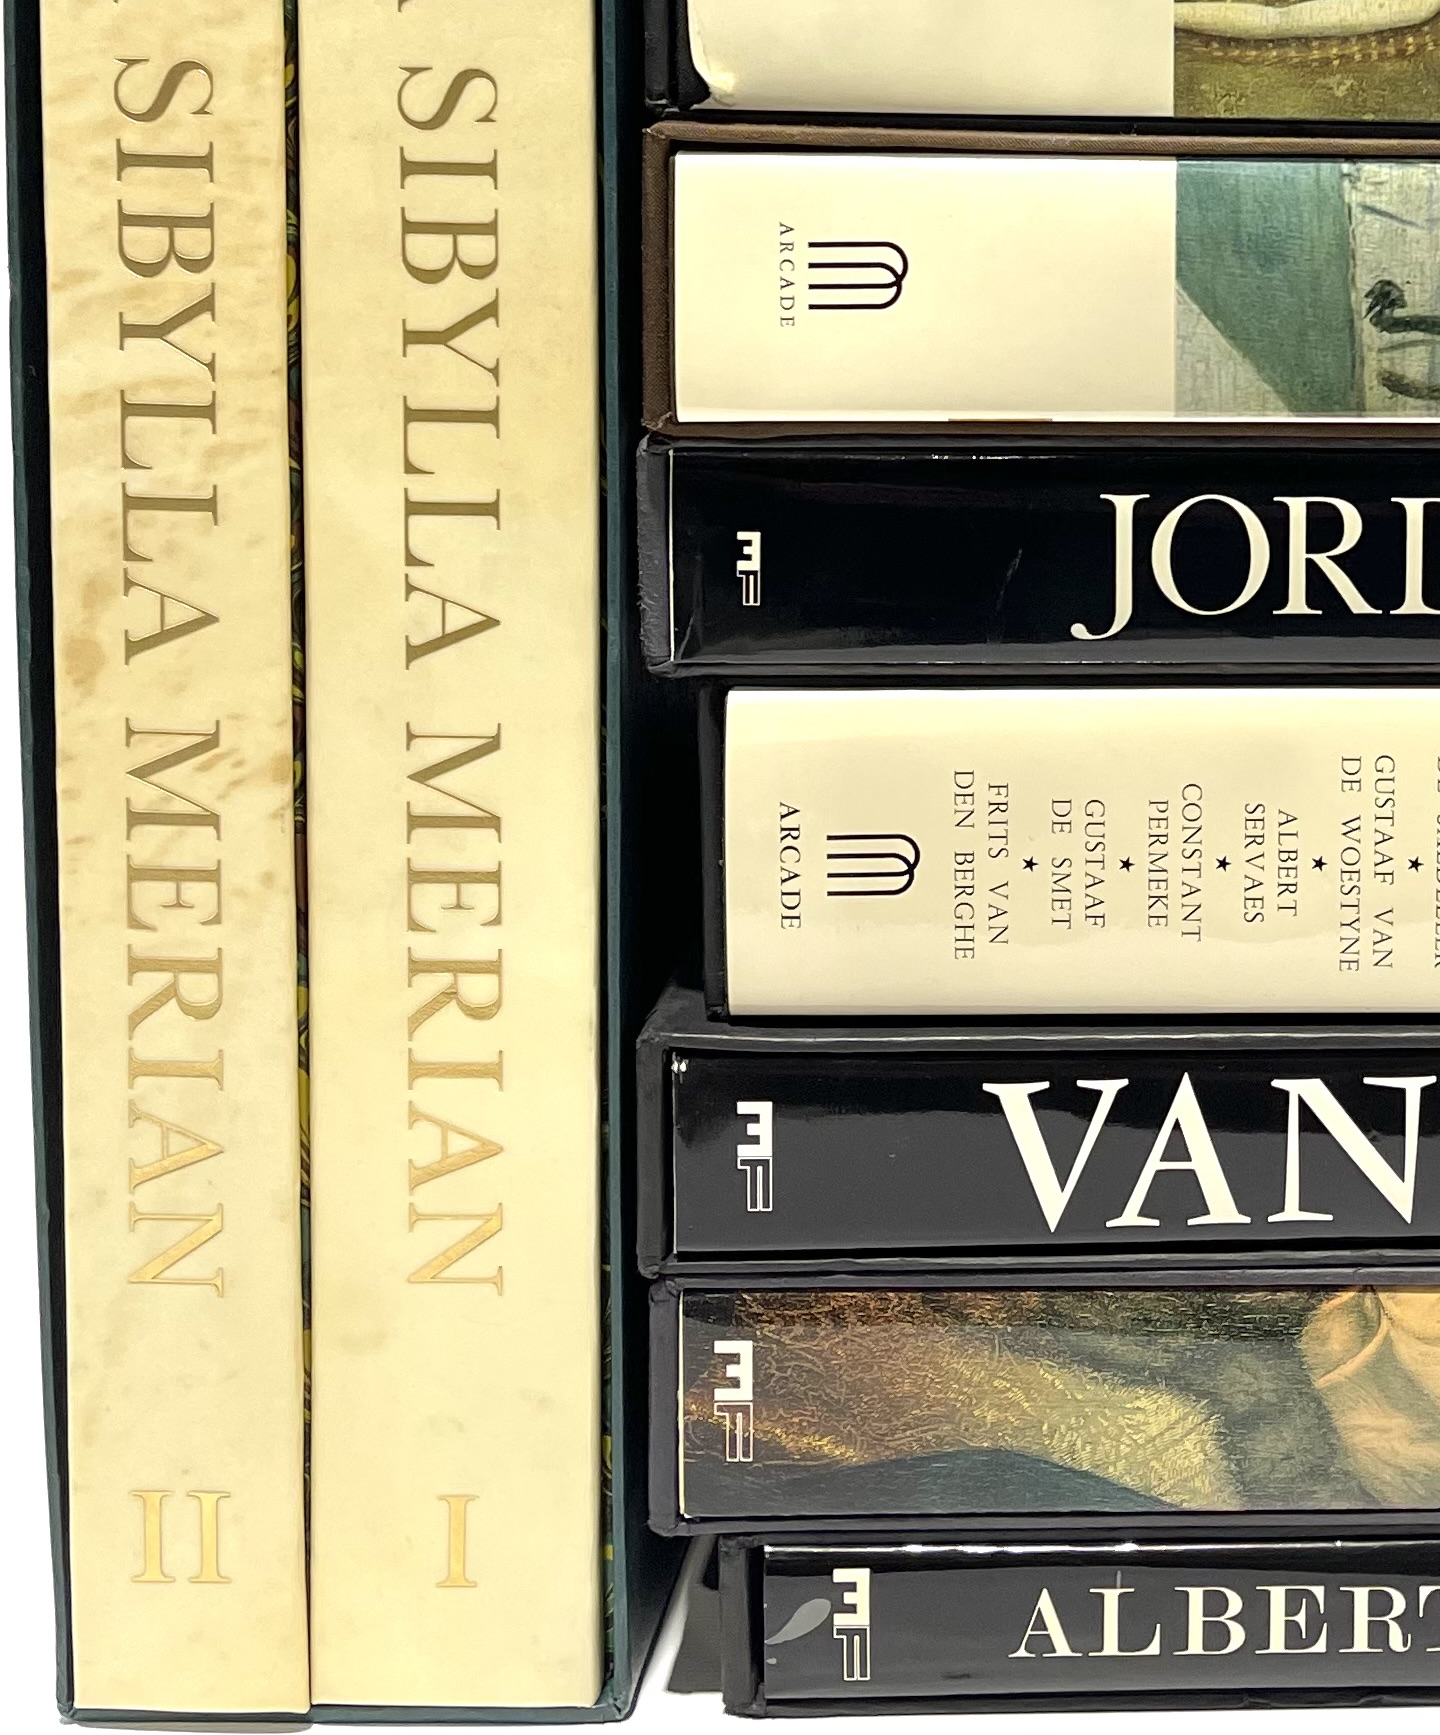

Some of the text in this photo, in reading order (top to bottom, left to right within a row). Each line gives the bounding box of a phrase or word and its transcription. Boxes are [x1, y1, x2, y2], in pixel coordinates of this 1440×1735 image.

[778, 220, 796, 329] ARCADE
[113, 57, 220, 667] SIBYLLA
[397, 66, 501, 671] SIBYLLA
[778, 801, 802, 930] ARCADE
[953, 770, 976, 961] DEN BERGHE
[987, 781, 1010, 945] FRITS VAN
[1051, 798, 1073, 930] DE SMET
[1084, 798, 1106, 929] GUSTAAF
[1147, 798, 1170, 929] PERMEKE
[1181, 783, 1203, 943] CONSTANT
[1243, 802, 1266, 924] SERVAES
[1276, 808, 1299, 917] ALBERT
[1338, 755, 1362, 972] DE WOESTYNE
[1372, 754, 1396, 969] GUSTAAF VAN
[125, 716, 226, 1298] MERIAN
[406, 720, 504, 1298] MERIAN
[980, 1070, 1438, 1234] VAN
[130, 1489, 232, 1586] II
[437, 1494, 478, 1590] I
